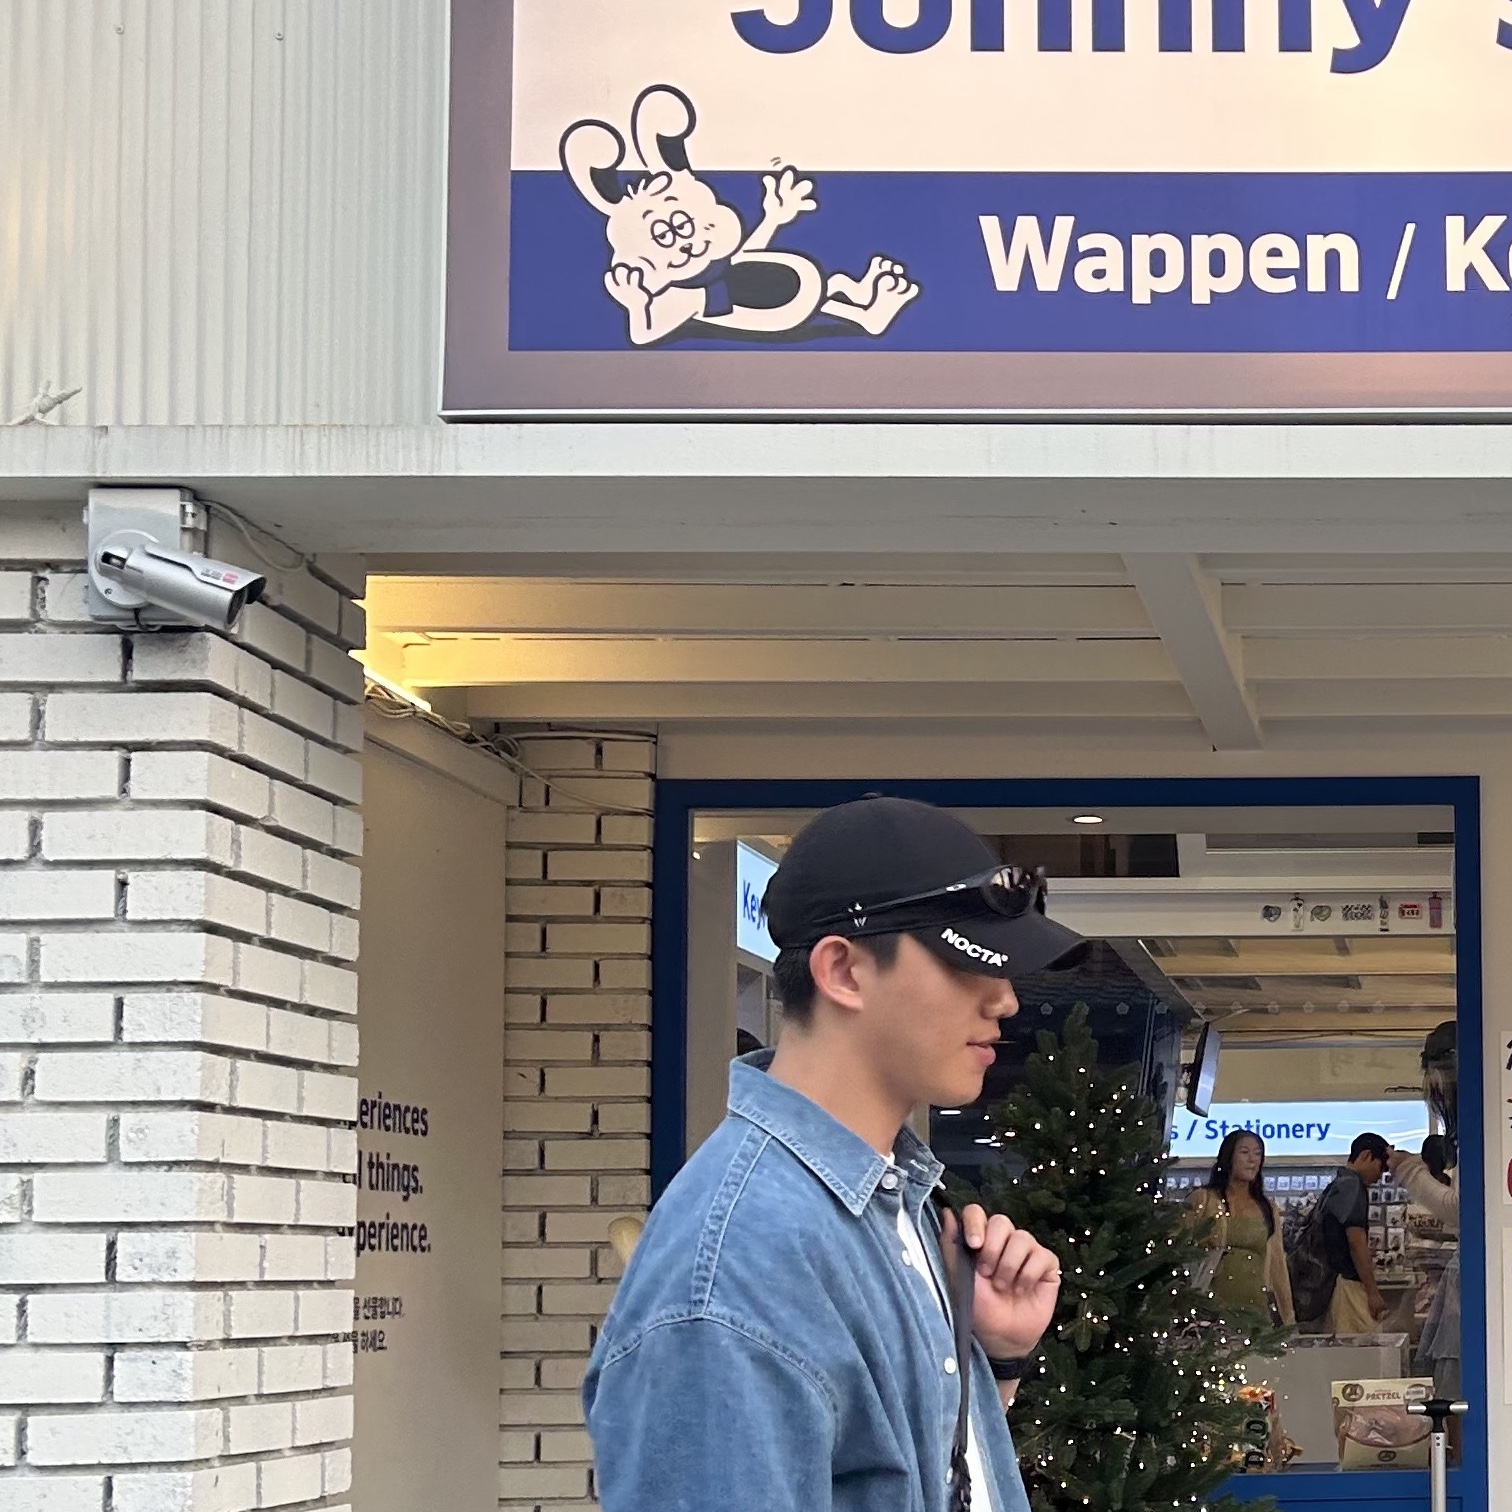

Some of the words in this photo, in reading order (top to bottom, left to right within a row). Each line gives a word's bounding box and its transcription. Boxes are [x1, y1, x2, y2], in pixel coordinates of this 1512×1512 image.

[979, 214, 1359, 306] Wappen
[941, 928, 1008, 967] NOCTA
[348, 1090, 429, 1137] eriences
[367, 1151, 423, 1202] things.
[337, 1211, 431, 1257] perience.
